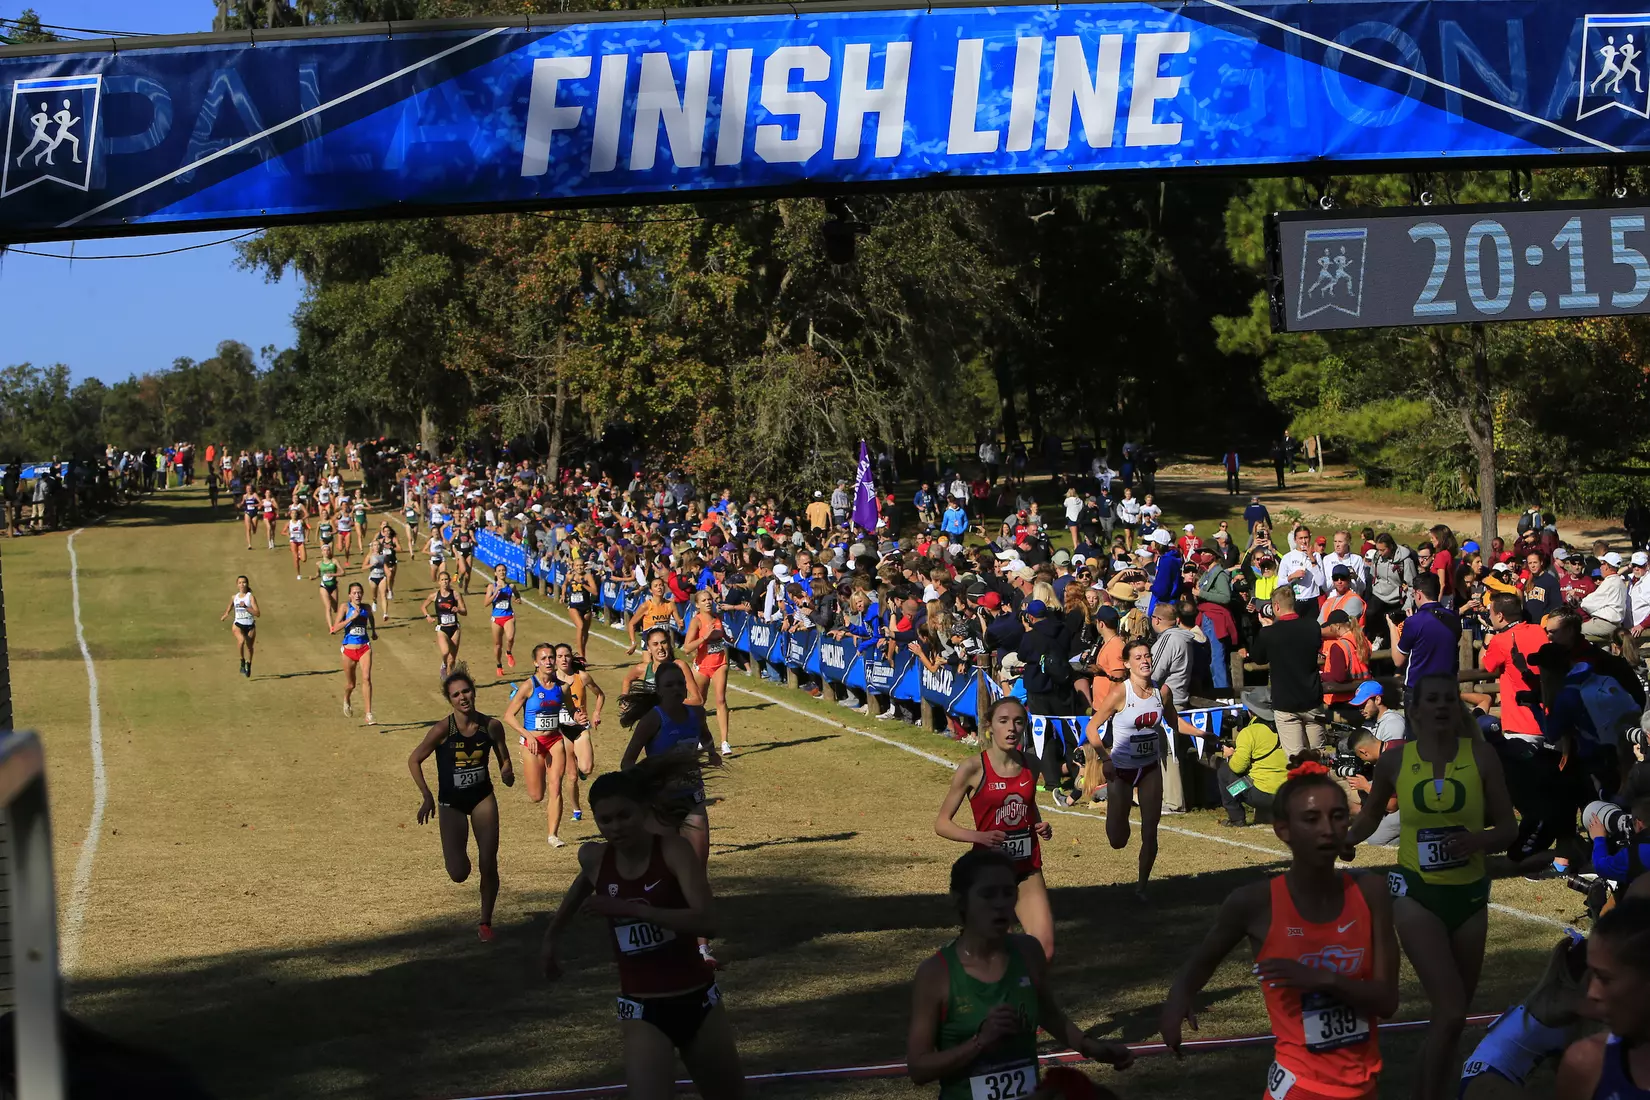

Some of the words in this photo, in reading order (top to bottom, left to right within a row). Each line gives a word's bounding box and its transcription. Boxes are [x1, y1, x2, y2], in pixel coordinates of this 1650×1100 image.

[520, 41, 913, 178] FINISH
[946, 32, 1191, 155] LINE
[1407, 214, 1650, 317] 20:15
[540, 718, 554, 728] 351
[455, 750, 483, 767] M
[1136, 741, 1154, 754] 494
[460, 772, 478, 785] 231
[629, 924, 664, 947] 408
[1319, 1006, 1358, 1040] 339
[985, 1070, 1028, 1100] 322
